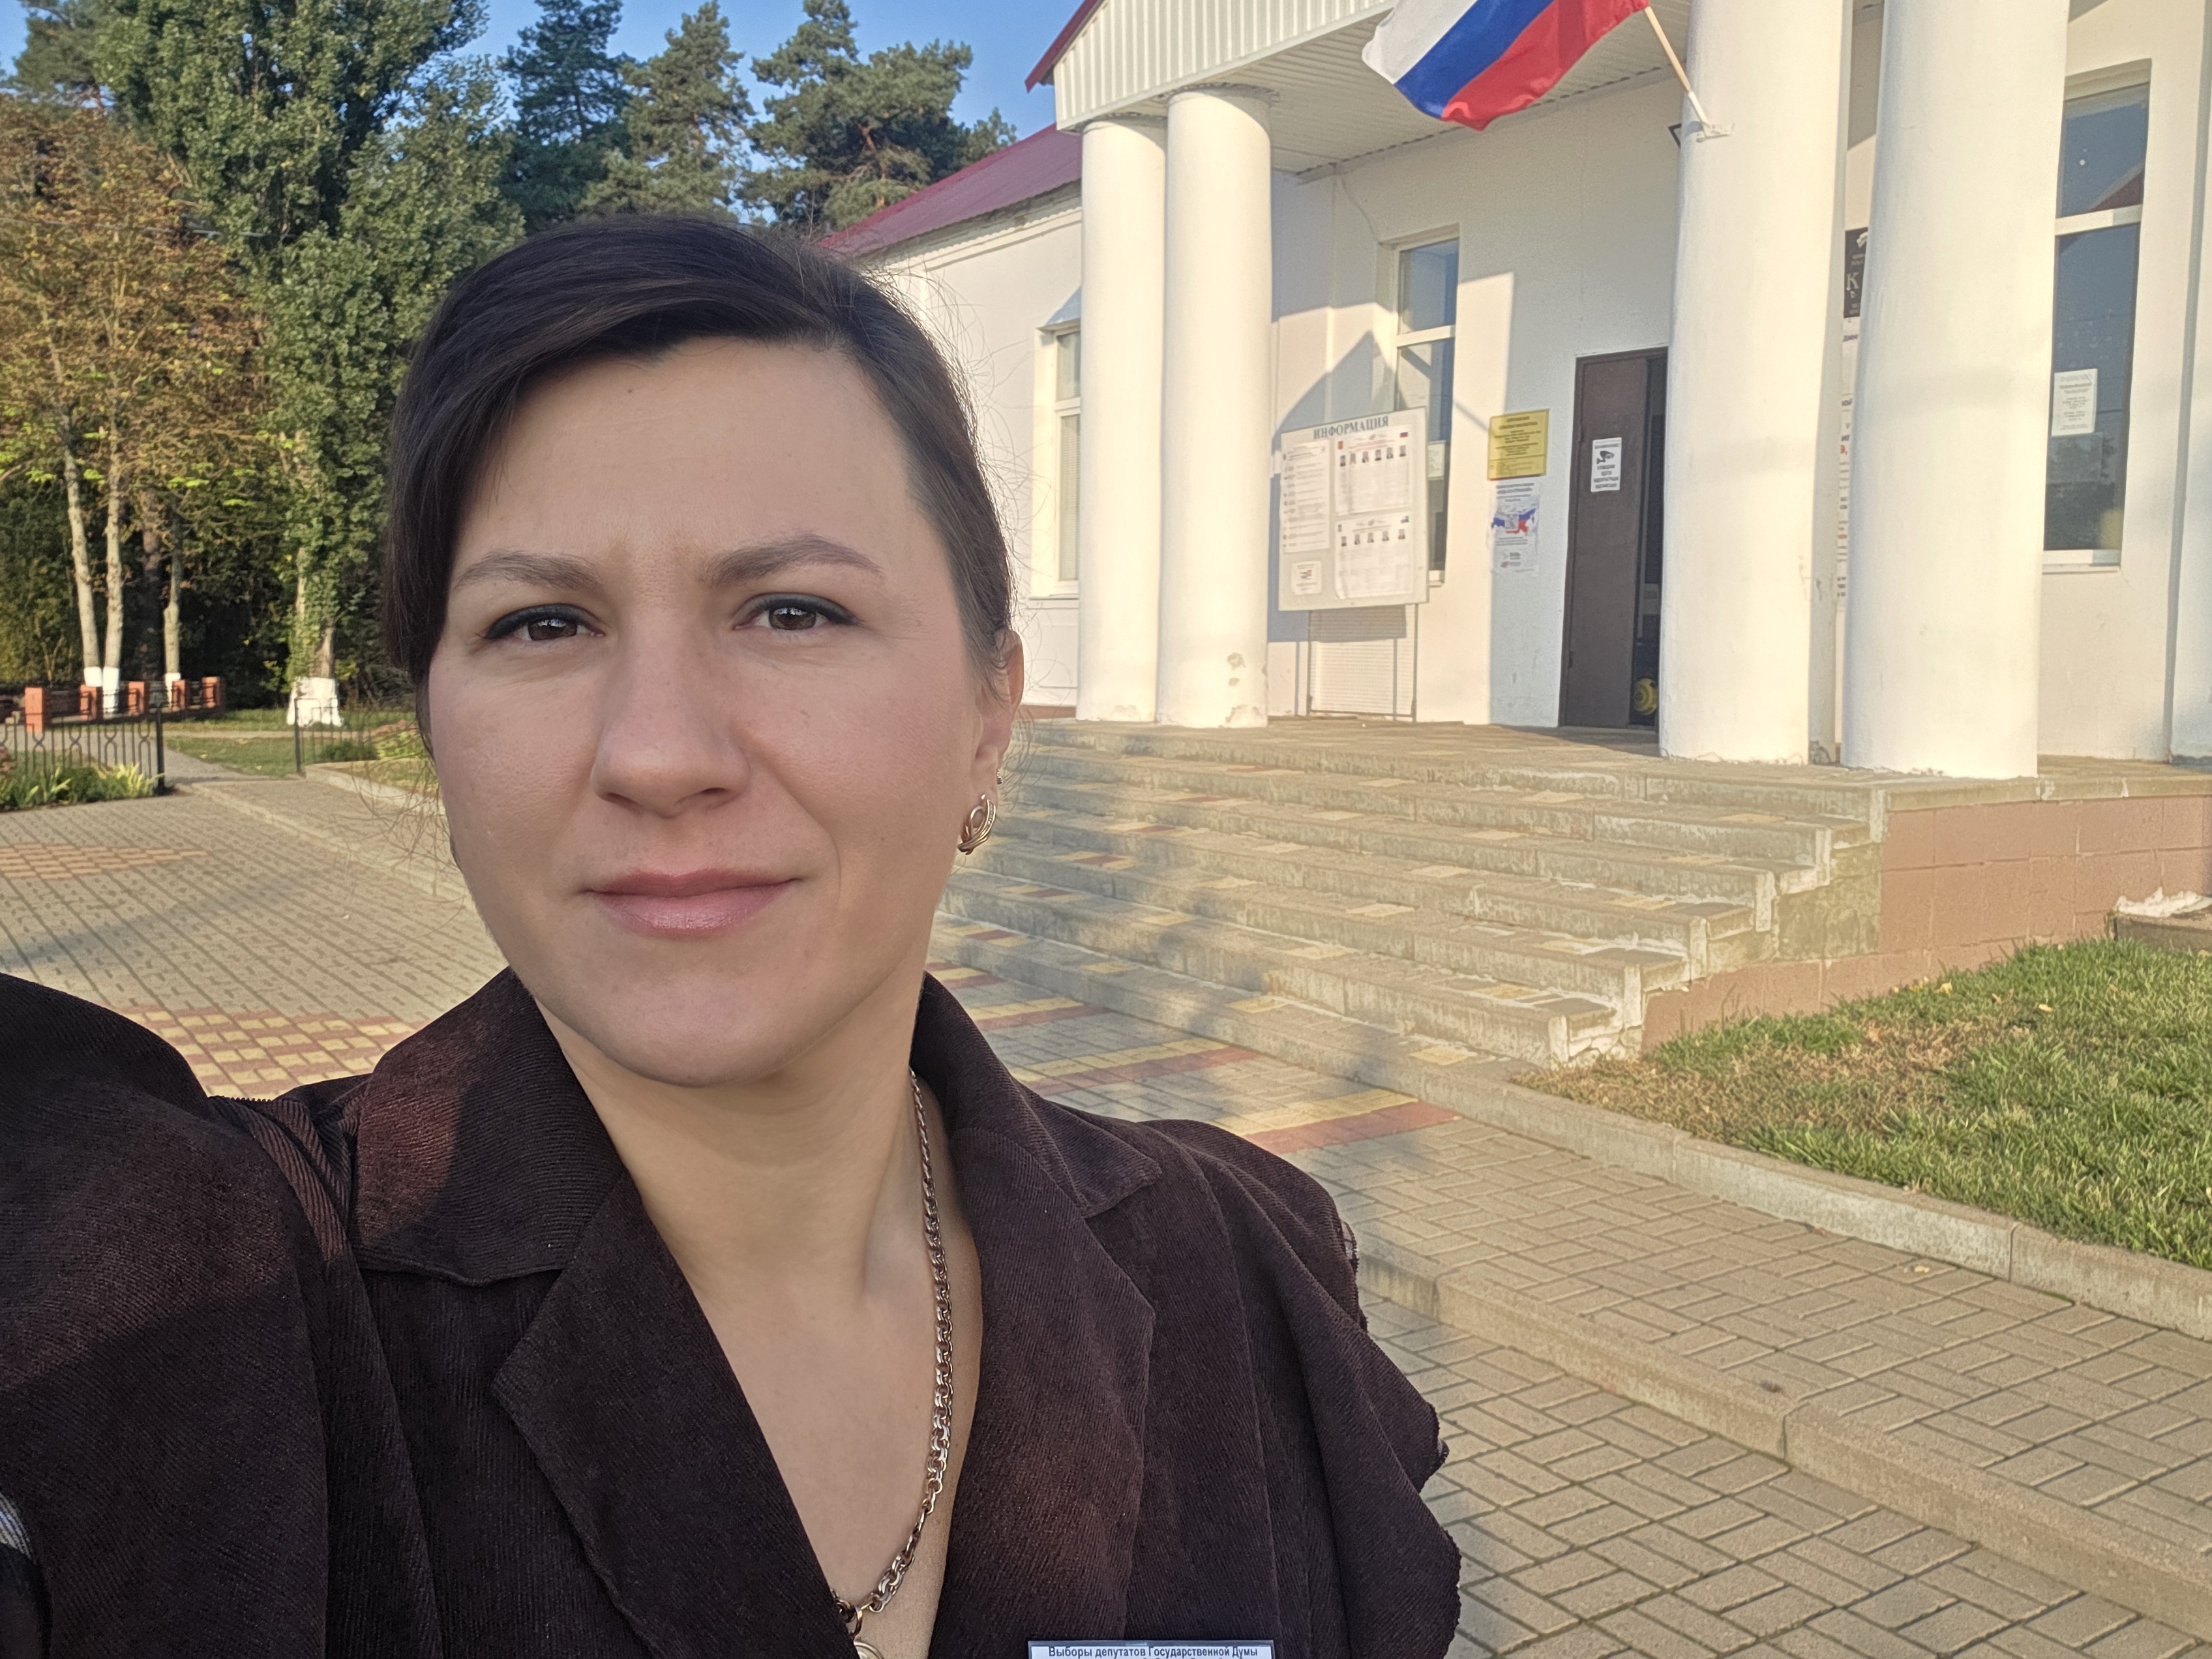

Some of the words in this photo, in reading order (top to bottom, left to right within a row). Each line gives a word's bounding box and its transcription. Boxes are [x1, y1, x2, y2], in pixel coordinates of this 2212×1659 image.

[1313, 415, 1389, 440] ИНФОРМАЦИЯ
[1049, 1646, 1092, 1658] Выборы
[1095, 1648, 1146, 1658] депутатов
[1148, 1646, 1230, 1658] Государственной
[1232, 1646, 1258, 1658] Думы
